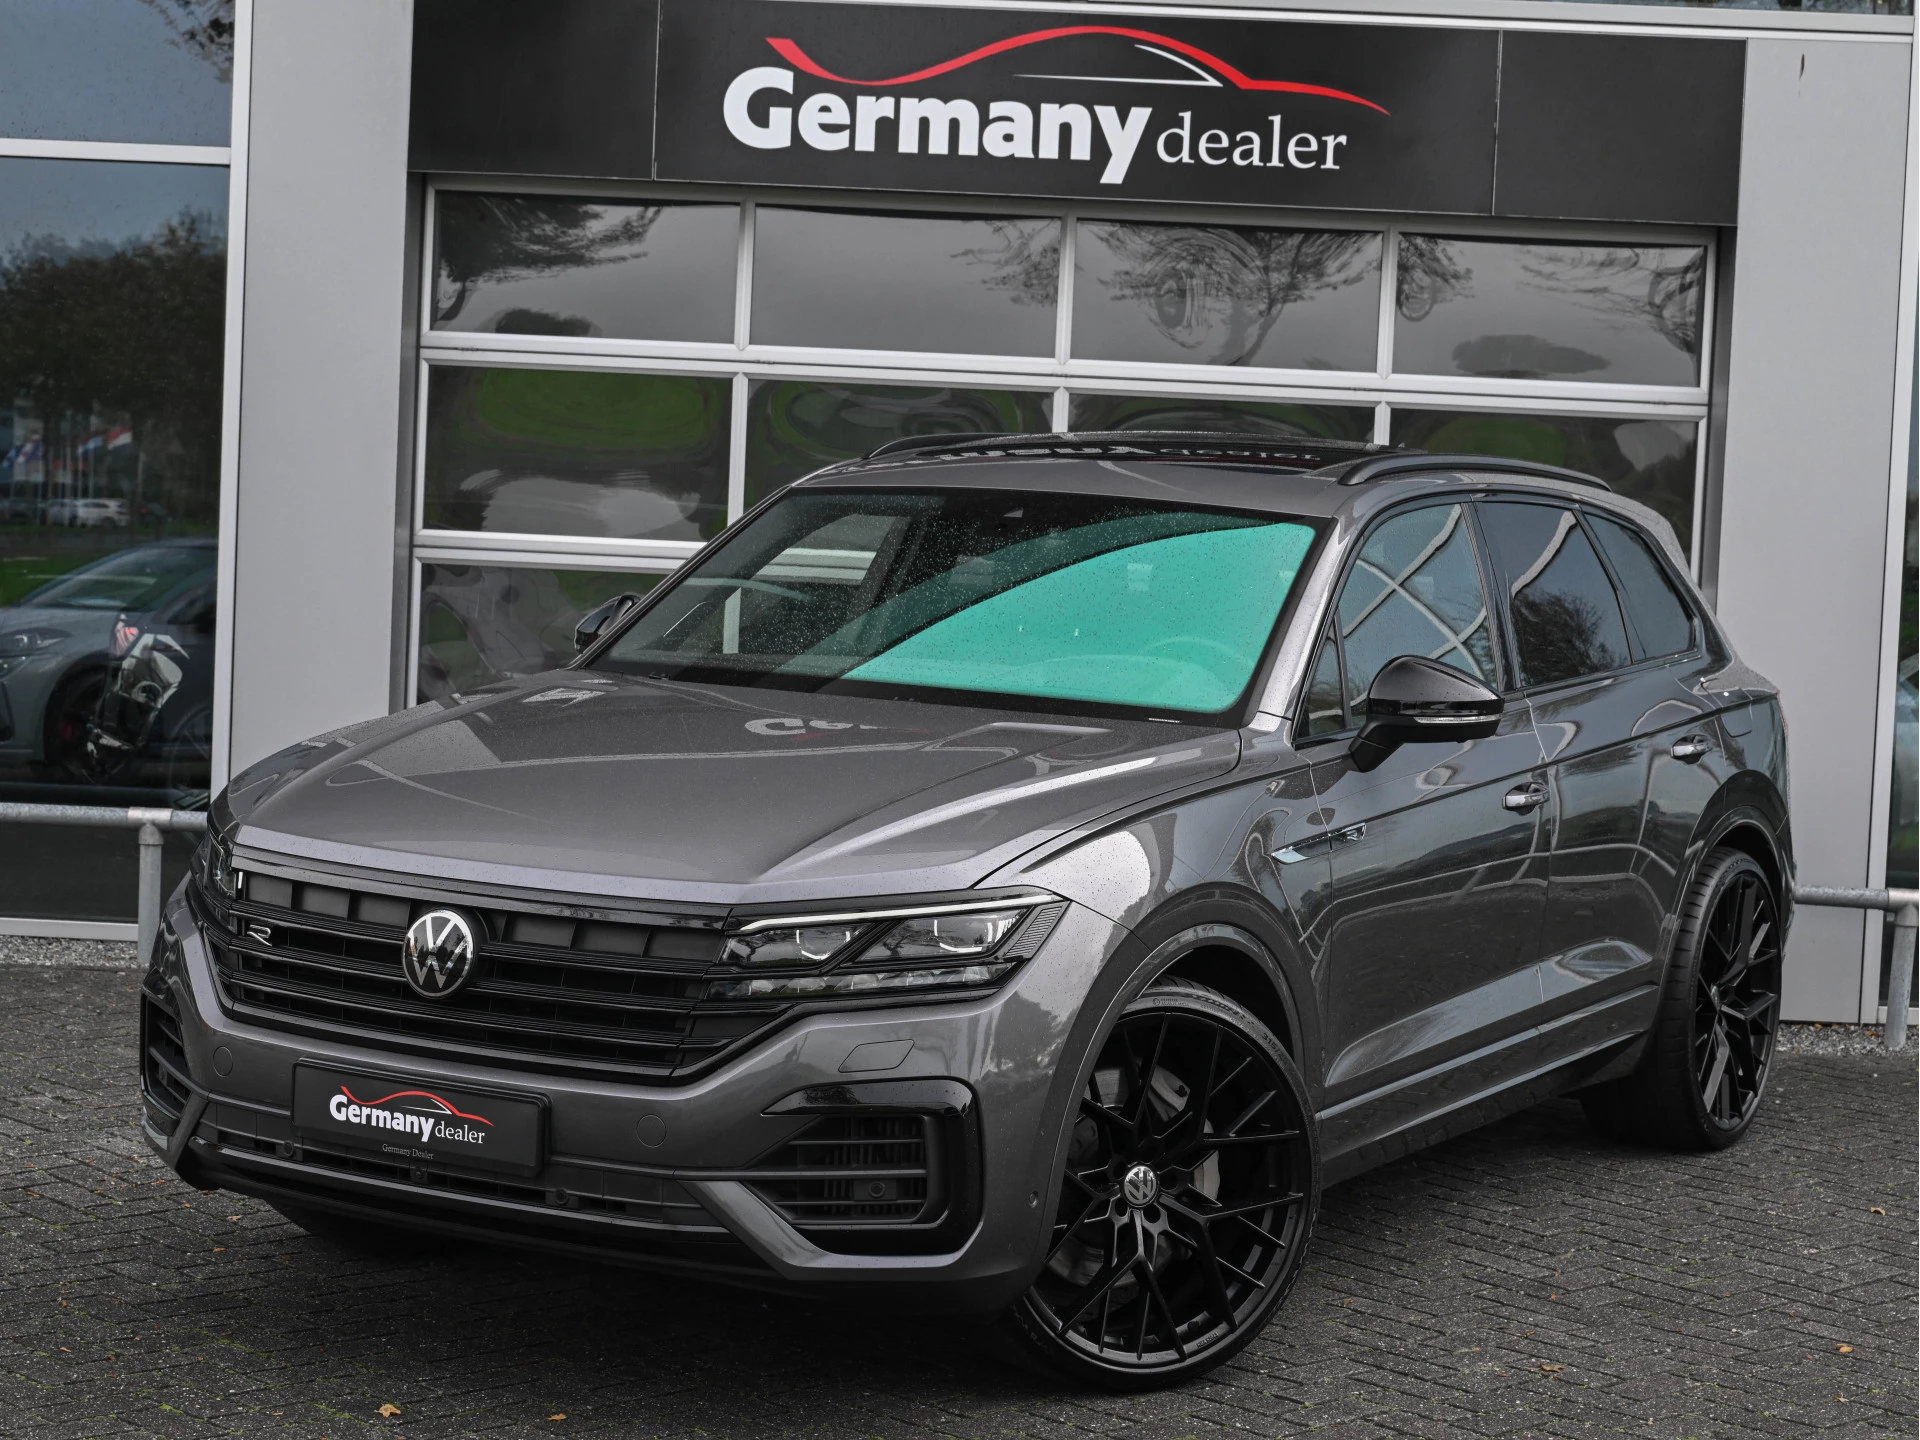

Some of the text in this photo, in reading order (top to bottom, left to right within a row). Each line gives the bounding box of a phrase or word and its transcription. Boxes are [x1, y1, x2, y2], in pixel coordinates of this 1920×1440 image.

[723, 66, 1348, 185] Germany dealer
[329, 1094, 485, 1144] Germany dealer
[382, 1143, 411, 1157] Germany
